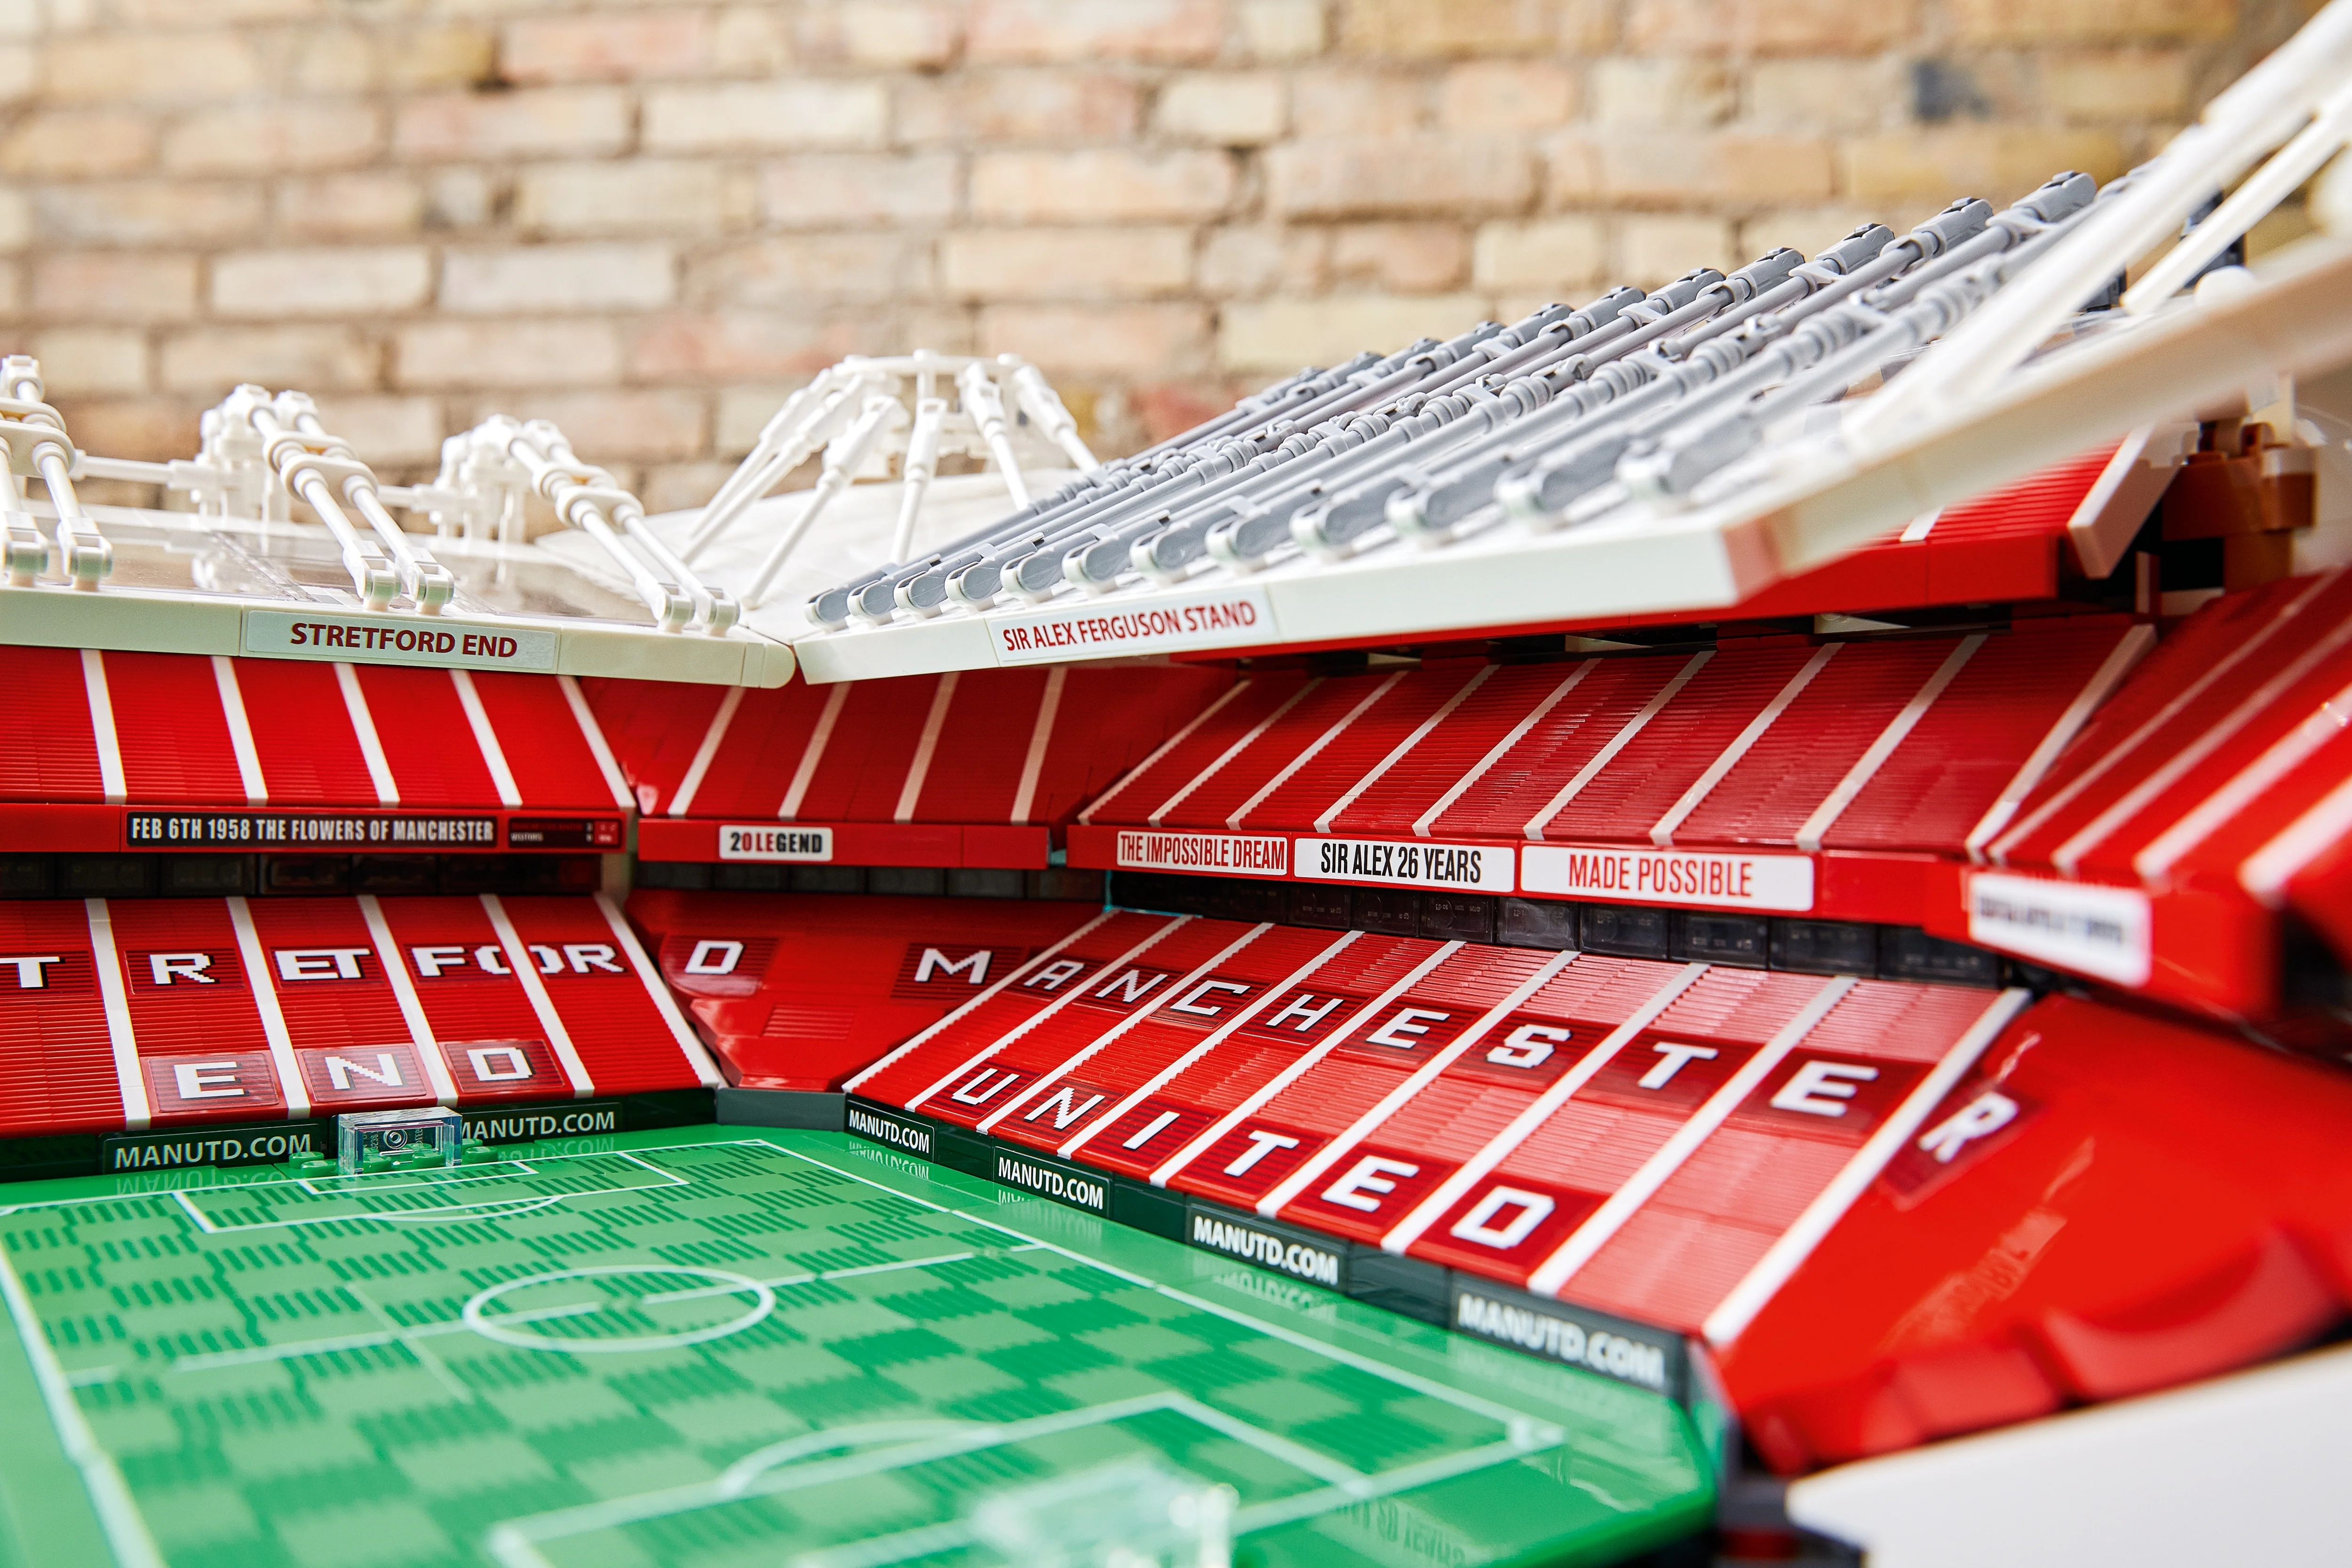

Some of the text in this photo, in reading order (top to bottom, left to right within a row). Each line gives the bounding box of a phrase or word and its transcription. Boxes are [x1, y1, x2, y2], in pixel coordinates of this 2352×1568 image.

[290, 622, 517, 657] STRETFORD END
[1002, 600, 1257, 651] SIR ALEX FERGUSON STAND
[131, 818, 494, 841] FEB 6TH 1958 THE FLOWERS OF MANCHESTER
[1120, 835, 1285, 870] THE IMPOSSIBLE DREAM
[1321, 842, 1482, 884] SIR ALEX 26 YEARS
[1568, 854, 1753, 897] MADE POSSIBLE
[114, 1134, 310, 1169] MANUTD.COM
[849, 1109, 930, 1154] MANUTD.COM
[998, 1156, 1104, 1210] MANUTD.COM
[1193, 1215, 1338, 1285] MANUTD.COM
[1458, 1293, 1665, 1387] MANUTD.COM
